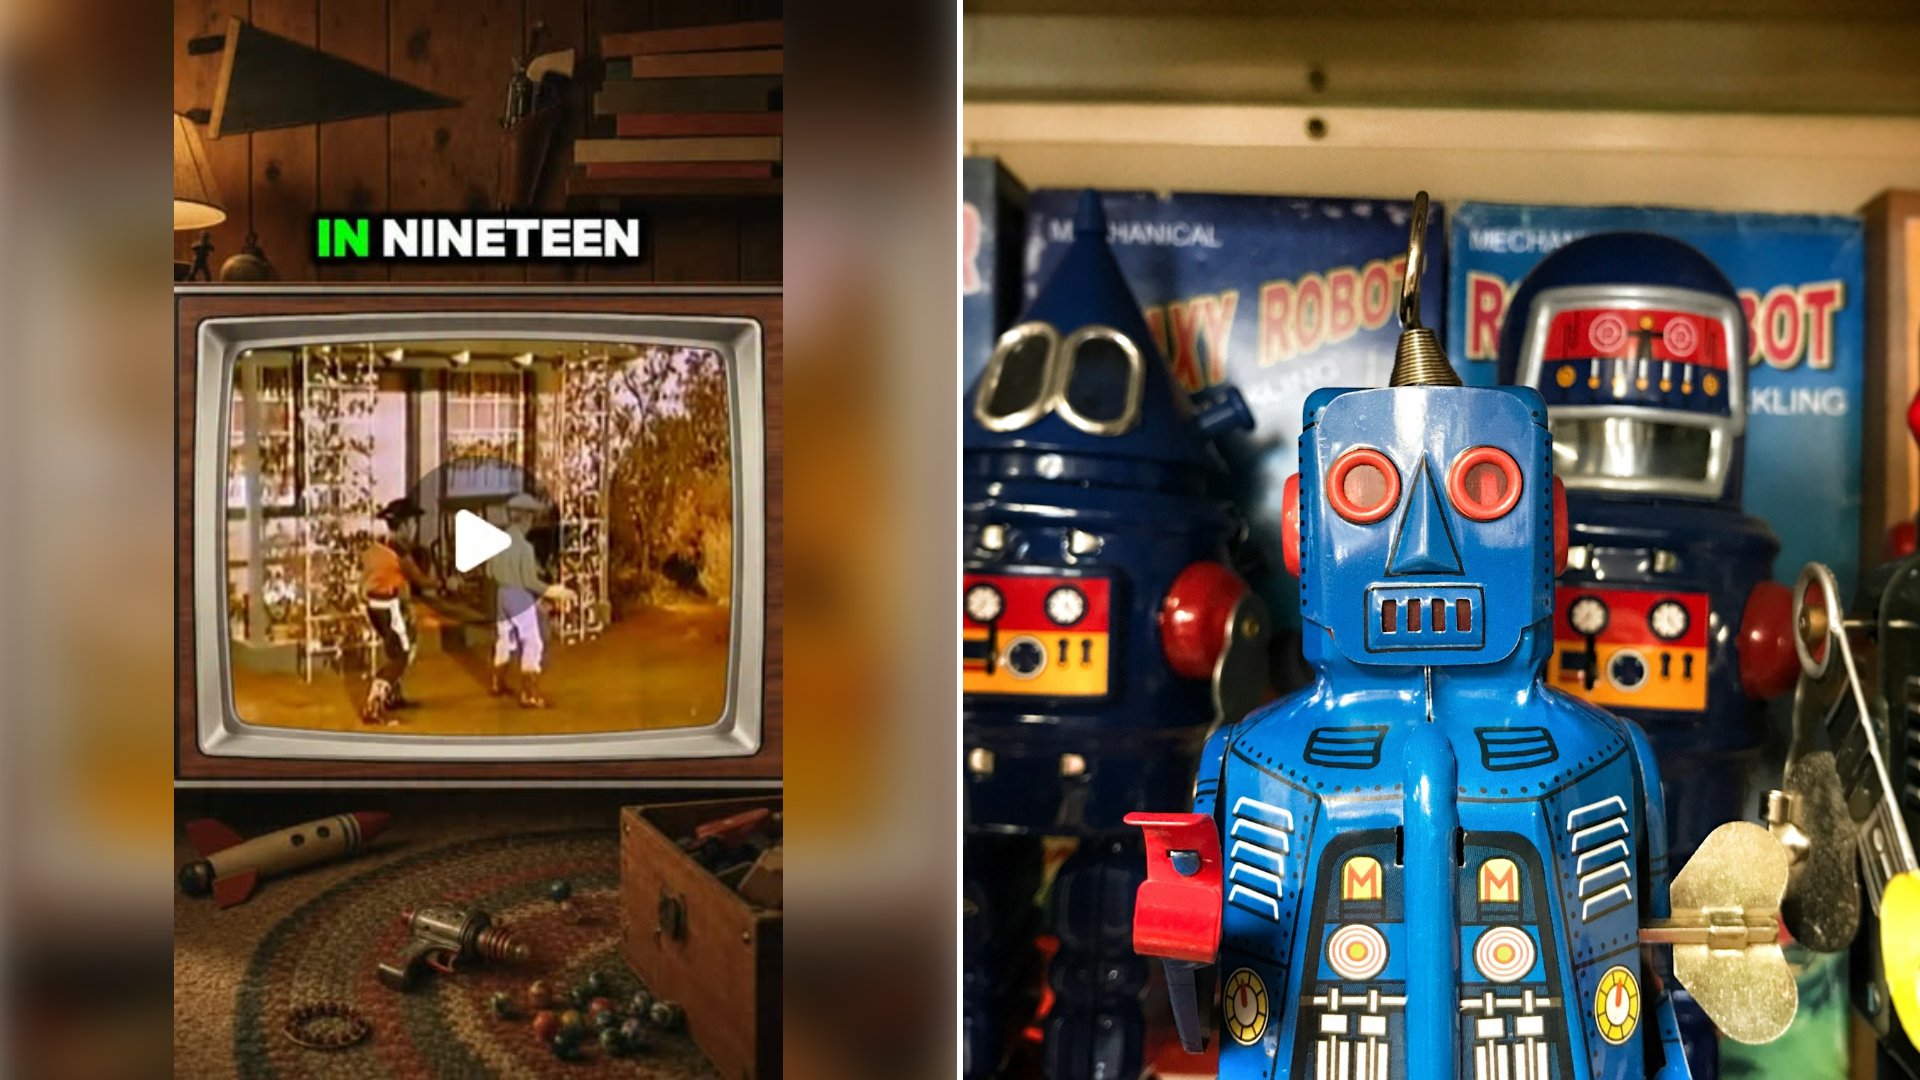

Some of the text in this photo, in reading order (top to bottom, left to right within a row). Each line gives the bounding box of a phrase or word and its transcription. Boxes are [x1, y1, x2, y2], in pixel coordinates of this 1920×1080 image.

[1050, 218, 1223, 248] MHANICAL
[1748, 386, 1847, 416] KLING
[1348, 862, 1378, 901] M
[1484, 865, 1515, 902] M
